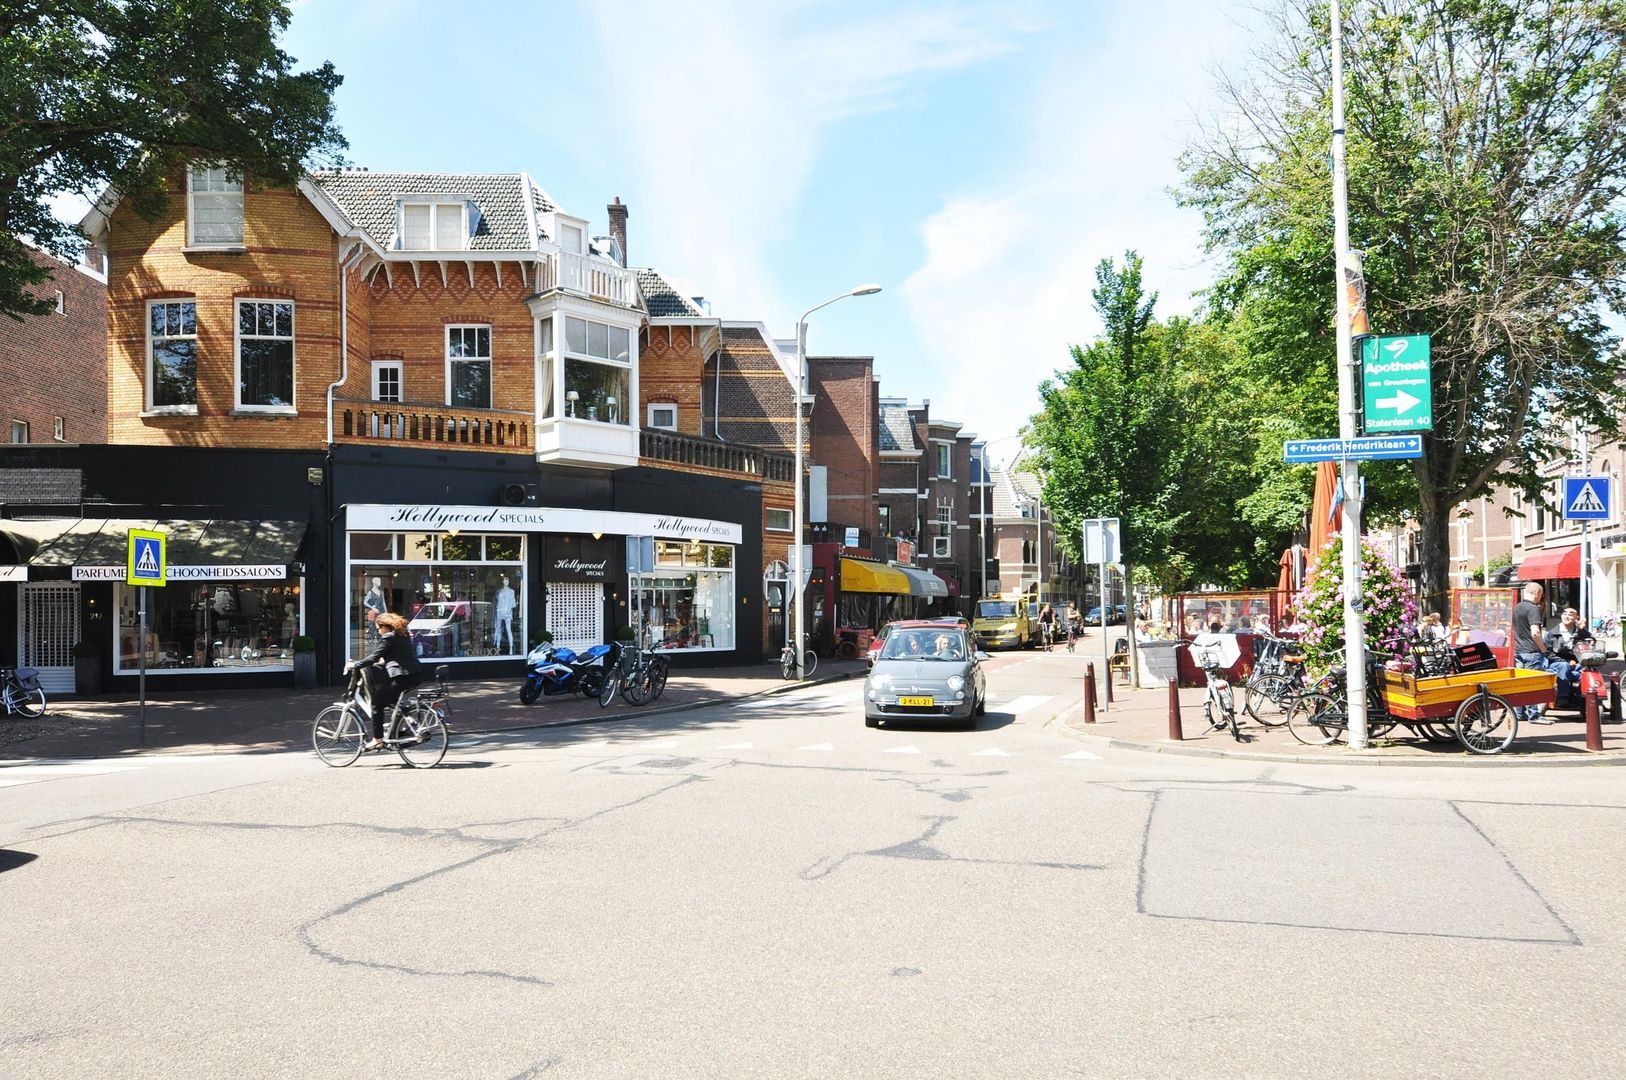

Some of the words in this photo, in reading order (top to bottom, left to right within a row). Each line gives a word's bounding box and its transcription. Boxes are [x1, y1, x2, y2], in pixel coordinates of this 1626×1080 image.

[1364, 359, 1429, 375] Apotheek
[1365, 416, 1414, 428] Statenlaan
[1417, 416, 1431, 425] 40
[1300, 442, 1342, 452] Frederik
[1344, 440, 1406, 452] Hendriklaan
[390, 506, 499, 528] Hollywood
[499, 513, 544, 524] SPECIALS
[653, 518, 712, 537] Hollywood
[711, 526, 730, 536] SPECIALS
[76, 568, 128, 579] PARFUME
[164, 567, 283, 579] CHOONHEIDSSALONS
[554, 558, 607, 573] Hollywood
